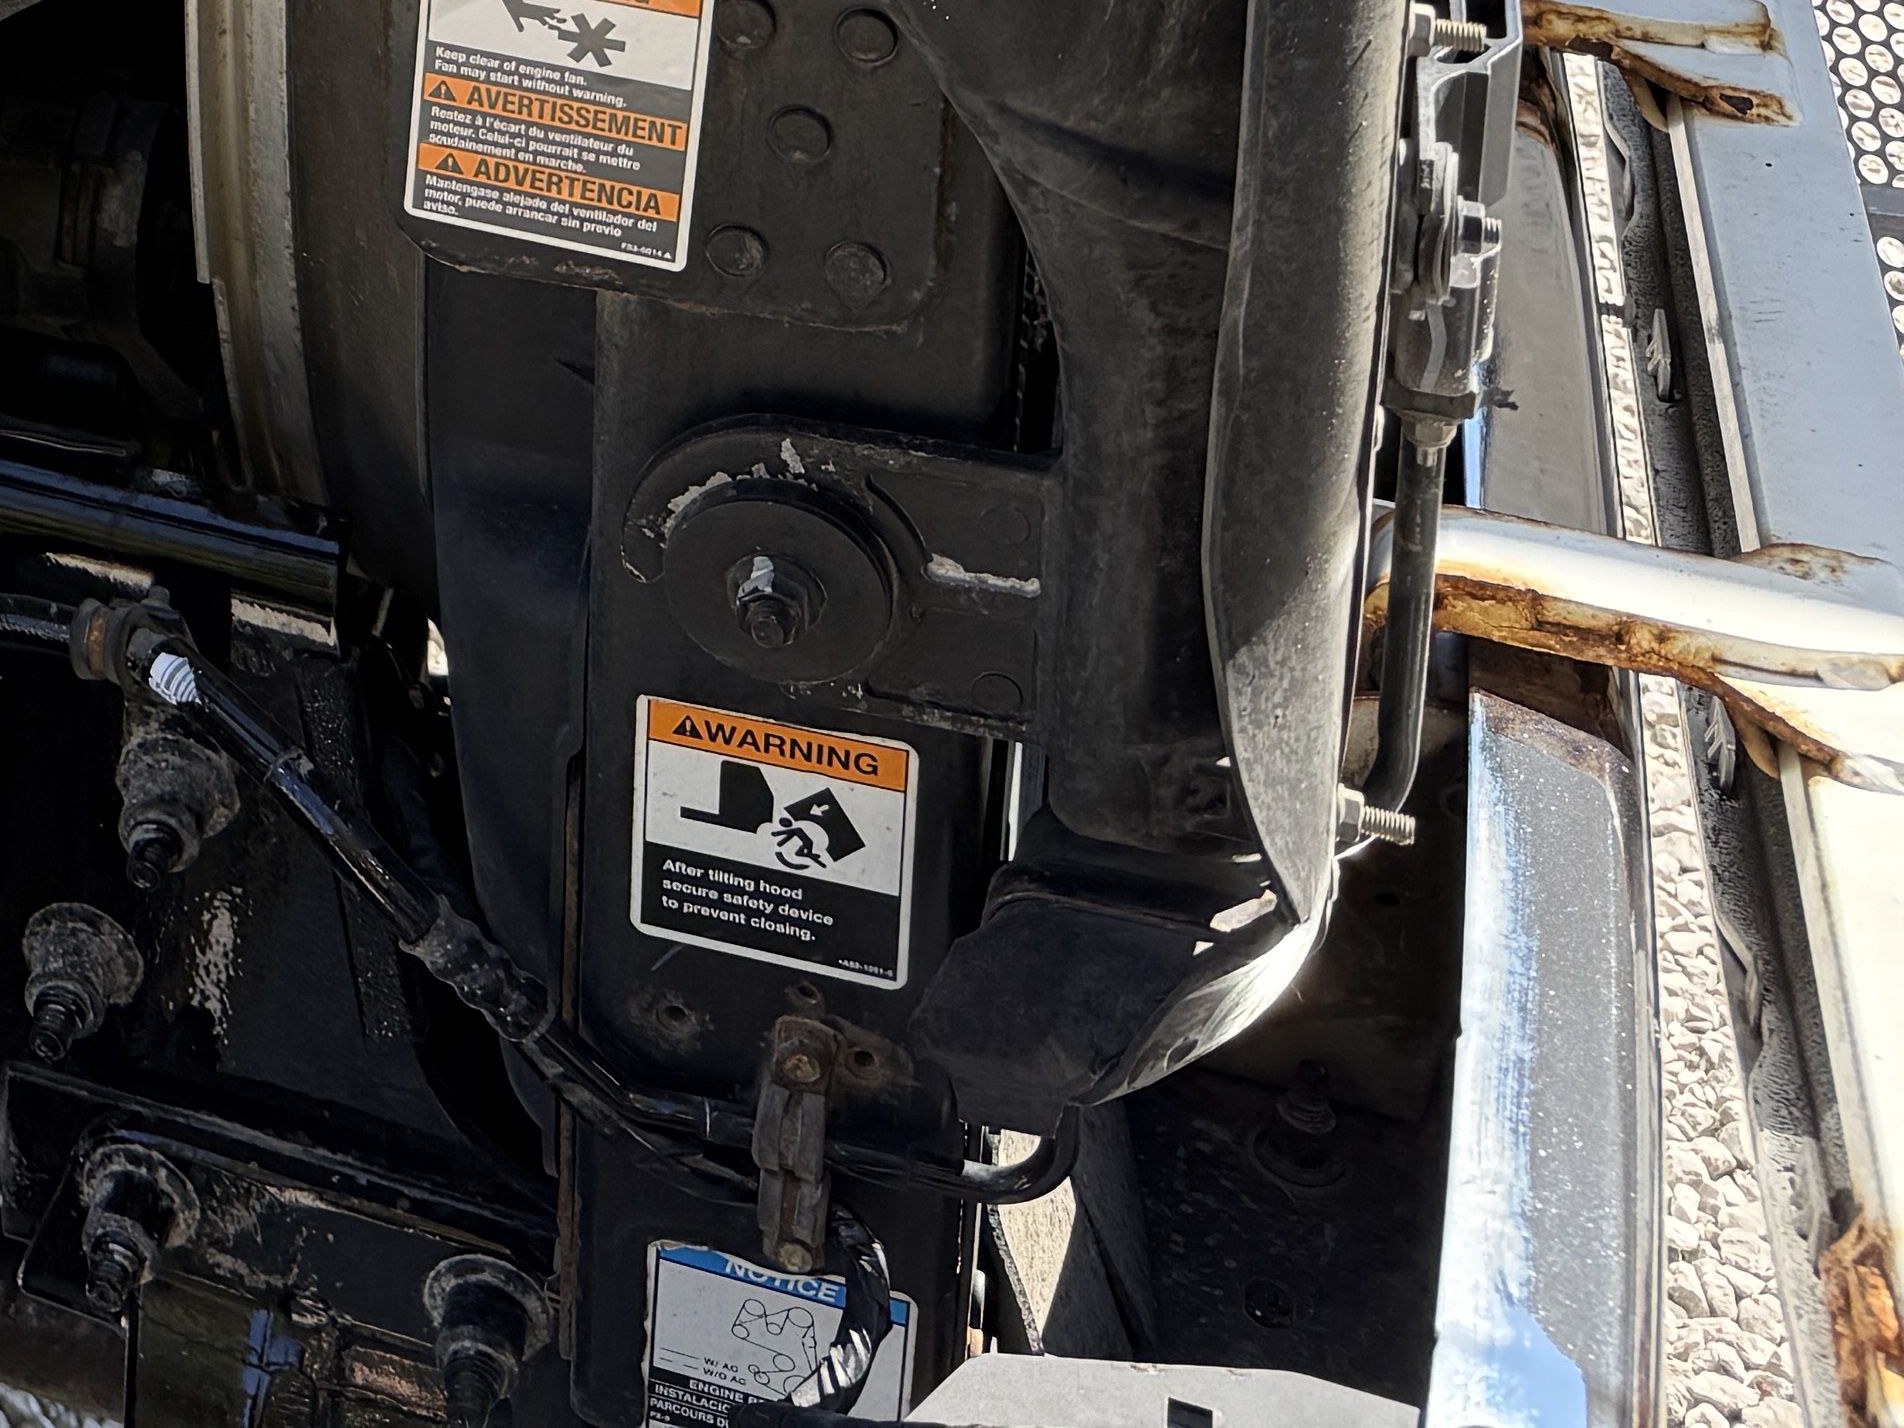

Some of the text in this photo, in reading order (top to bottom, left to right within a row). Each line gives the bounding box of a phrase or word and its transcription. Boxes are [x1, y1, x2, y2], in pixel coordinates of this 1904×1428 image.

[435, 60, 627, 107] Fan may start without warning.
[436, 46, 587, 86] Keep clear of engine fan.
[431, 106, 471, 124] Restez
[475, 113, 482, 125] à
[528, 125, 544, 139] du
[548, 130, 614, 152] ventilateur
[617, 142, 633, 156] du
[466, 85, 682, 146] AVERTISSEMENT
[430, 121, 641, 171] moteur. Celui-ci pourrait se mettre
[518, 151, 532, 161] en
[536, 153, 587, 173] marche.
[423, 201, 458, 216] aviso.
[426, 174, 657, 233] Mantengase alejado del ventilador del
[473, 156, 661, 215] ADVERTENCIA
[465, 196, 503, 213] puede
[506, 206, 557, 225] arrancar
[561, 215, 579, 228] sin
[583, 221, 622, 238] previo
[703, 720, 880, 776] WARNING
[663, 858, 803, 901] After tilting hood
[663, 878, 834, 927] secure safety device
[661, 895, 816, 942] to prevent closing.
[650, 1397, 714, 1424] PARCOURS
[689, 1379, 744, 1403] ENGINE
